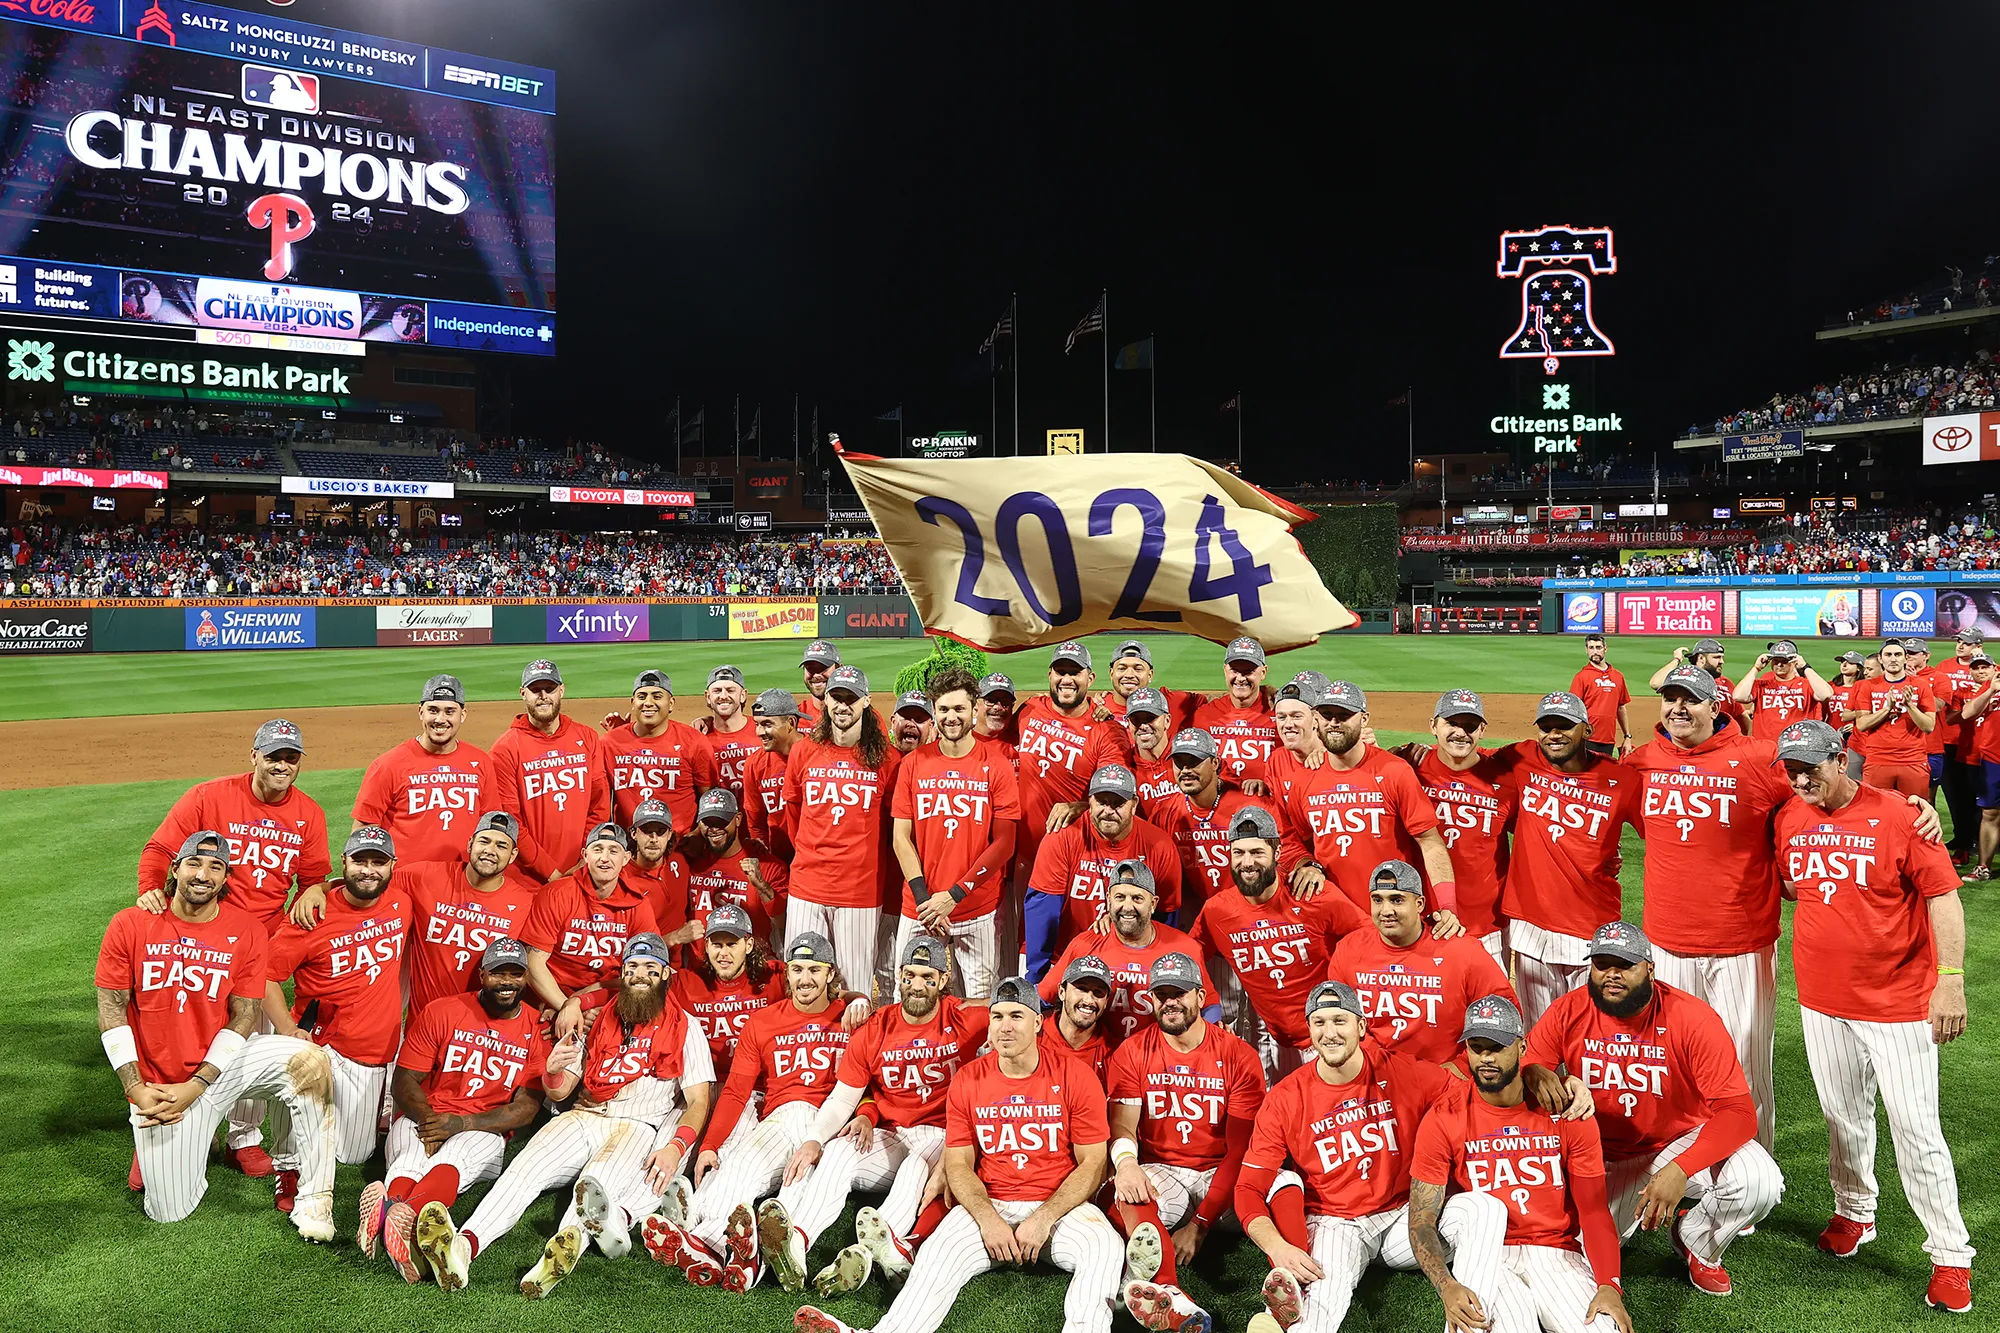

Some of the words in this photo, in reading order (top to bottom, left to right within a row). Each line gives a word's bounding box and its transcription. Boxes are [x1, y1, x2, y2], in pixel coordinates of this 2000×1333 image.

[181, 12, 229, 33] SALTZ
[236, 22, 336, 52] MONGELUZZI
[342, 42, 417, 66] BENDESKY
[230, 42, 290, 62] INJURY
[303, 54, 375, 77] LAWYERS
[133, 93, 177, 119] NL
[187, 104, 271, 131] EAST
[280, 116, 416, 155] DIVISION
[64, 109, 471, 216] CHAMPIONS
[183, 183, 228, 206] 20
[332, 203, 374, 225] 24
[245, 193, 316, 282] P
[34, 267, 92, 288] Building
[34, 281, 75, 298] brave
[228, 293, 242, 302] NL
[247, 295, 276, 304] EAST
[281, 298, 333, 309] DIVISION
[204, 298, 355, 331] CHAMPIONS
[264, 323, 298, 332] 2024
[434, 315, 535, 339] Independence
[63, 351, 196, 384] Citizens
[202, 360, 279, 390] Bank
[285, 365, 351, 396] Park
[207, 390, 264, 400] HARRY
[1490, 415, 1569, 434] Citizens
[1572, 413, 1623, 433] Bank
[911, 437, 930, 448] CP
[931, 436, 977, 448] RANKIN
[1534, 434, 1578, 454] Park
[0, 467, 23, 486] EAM
[39, 470, 61, 486] JIM
[61, 467, 95, 488] BEAM
[110, 472, 132, 488] JIM
[132, 470, 164, 490] BEAM
[748, 476, 789, 487] GIANT
[309, 480, 369, 493] LISCIO'S
[374, 483, 428, 495] BAKERY
[573, 489, 621, 503] TOYOTA
[646, 493, 692, 505] TOYOTA
[1403, 536, 1452, 547] Budweiser
[1460, 534, 1530, 545] #HITTHEBUDS
[1544, 534, 1595, 544] Budweiser
[1609, 531, 1684, 543] #HITTHEBUDS
[914, 487, 1273, 628] 2024
[1675, 577, 1713, 585] Independence
[1751, 576, 1776, 584] ibx.com
[1808, 574, 1852, 583] Independence
[1896, 573, 1924, 582] ibx.com
[9, 599, 83, 608] ASPLUNDH
[96, 599, 166, 607] ASPLUNDH
[177, 599, 244, 607] ASPLUNDH
[252, 598, 320, 607] ASPLUNDH
[331, 598, 390, 606] ASPLUNDH
[401, 598, 459, 606] ASPLUNDH
[469, 598, 524, 606] ASPLUNDH
[534, 597, 587, 605] ASPLUNDH
[595, 597, 646, 605] ASPLUNDH
[711, 596, 758, 604] ASPLUNDH
[767, 596, 812, 604] ASPLUNDH
[1655, 595, 1716, 614] Temple
[1901, 599, 1916, 612] R
[399, 608, 473, 628] Yuengling
[709, 605, 726, 618] 374
[732, 611, 746, 619] WHO
[746, 610, 759, 618] BUT
[823, 604, 840, 617] 387
[222, 610, 302, 628] SHERWIN
[558, 609, 639, 640] xfinity
[846, 613, 909, 628] GIANT
[1656, 615, 1713, 632] Health
[1883, 620, 1934, 629] ROTHMAN
[221, 627, 306, 646] WILLIAMS.
[412, 630, 459, 642] LAGER
[0, 639, 85, 650] EHABILITATION
[408, 773, 429, 786] WE
[429, 772, 458, 785] OWN
[458, 773, 479, 785] THE
[917, 778, 937, 790] WE
[937, 778, 965, 791] OWN
[965, 780, 989, 792] THE
[1650, 772, 1669, 784] WE
[1669, 773, 1704, 787] OWN
[1706, 775, 1737, 790] THE
[407, 786, 480, 816] EAST
[916, 792, 989, 823] EAST
[1644, 786, 1738, 825] EAST
[1788, 833, 1807, 847] WE
[1807, 833, 1841, 848] OWN
[1843, 834, 1876, 850] THE
[1788, 851, 1876, 888] EAST
[146, 943, 171, 957] WE
[172, 944, 202, 959] OWN
[203, 949, 233, 966] THE
[141, 960, 229, 1001] EAST
[1355, 972, 1378, 985] WE
[1378, 973, 1412, 987] OWN
[1413, 975, 1442, 989] THE
[1355, 988, 1444, 1025] EAST
[974, 1105, 999, 1119] WE
[999, 1105, 1033, 1118] OWN
[1034, 1104, 1062, 1117] THE
[1309, 1116, 1336, 1135] WE
[1335, 1106, 1368, 1126] OWN
[1367, 1099, 1393, 1117] THE
[974, 1121, 1064, 1155] EAST
[1313, 1117, 1399, 1175] EAST
[1464, 1139, 1491, 1154] WE
[1491, 1136, 1531, 1152] OWN
[1531, 1135, 1561, 1149] THE
[1464, 1152, 1564, 1193] EAST
